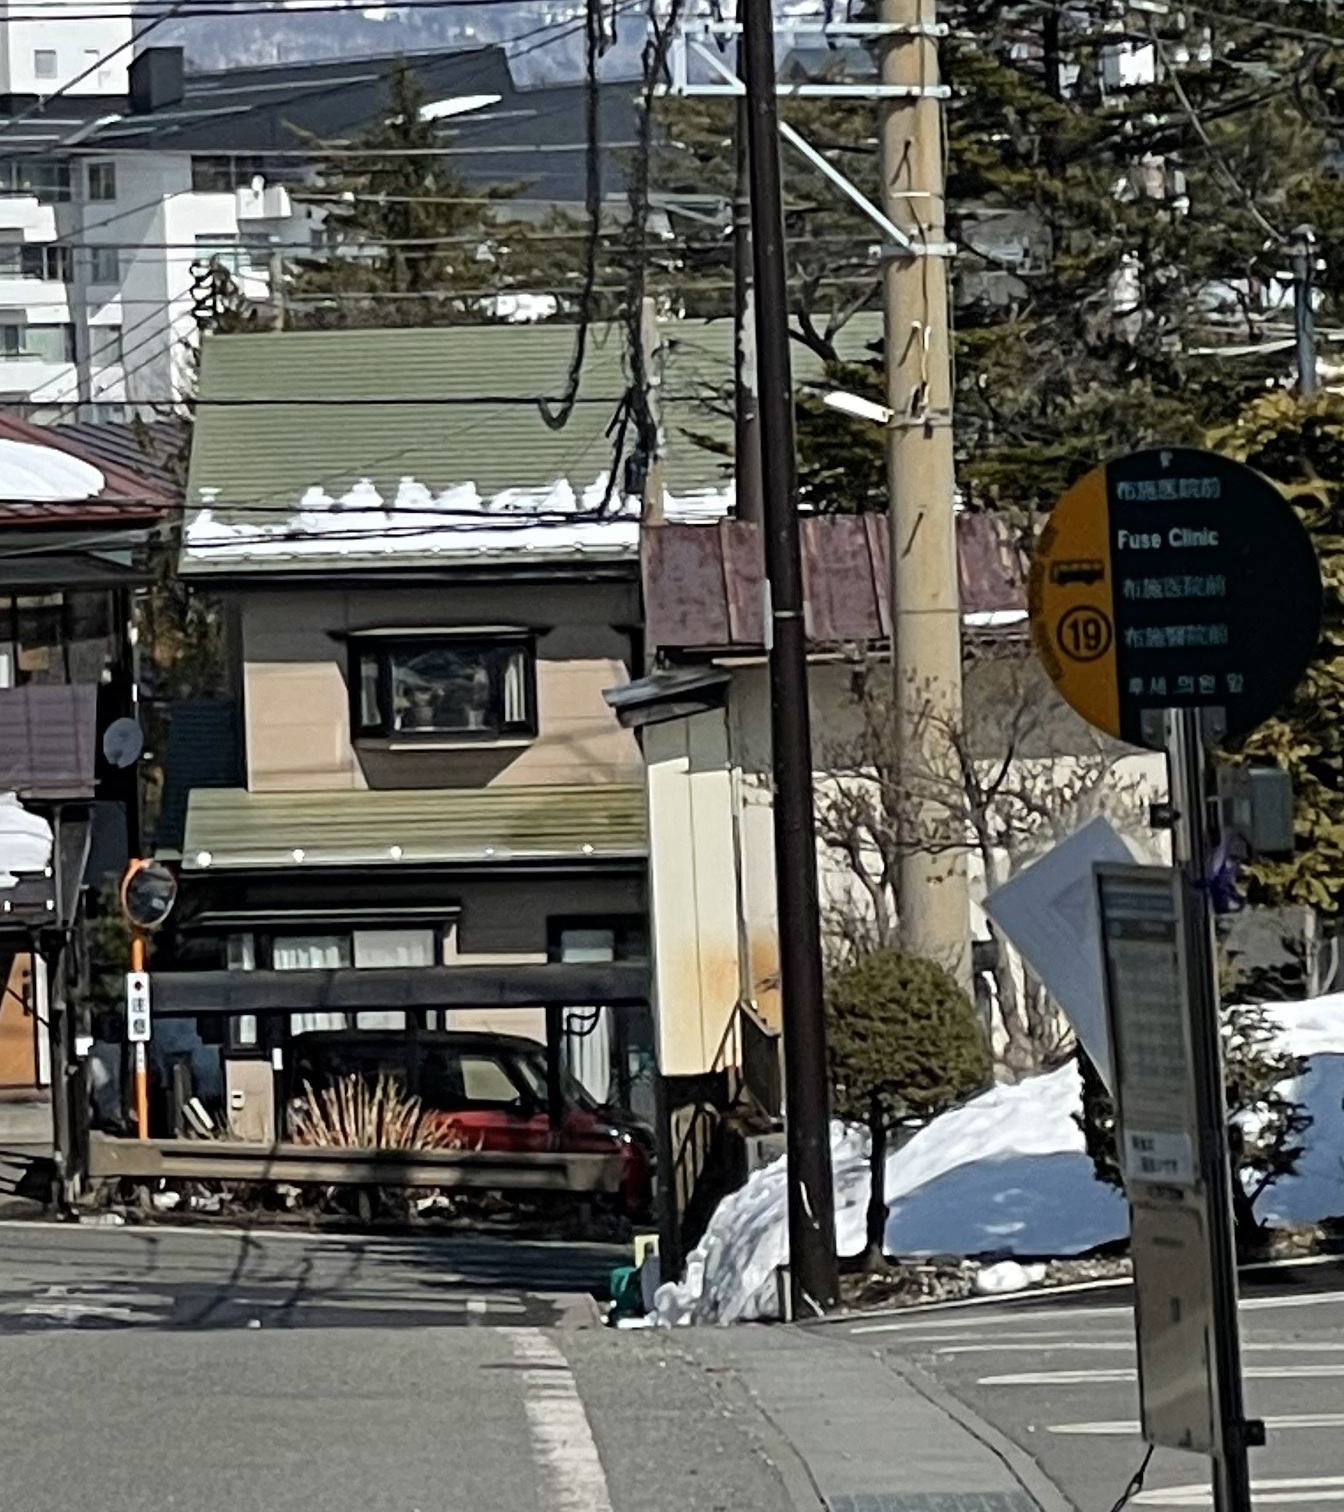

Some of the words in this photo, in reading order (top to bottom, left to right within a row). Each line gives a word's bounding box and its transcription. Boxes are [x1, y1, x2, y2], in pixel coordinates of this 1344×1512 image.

[1118, 530, 1162, 549] Fuse
[1168, 527, 1219, 548] Clinic
[1069, 617, 1102, 652] 19
